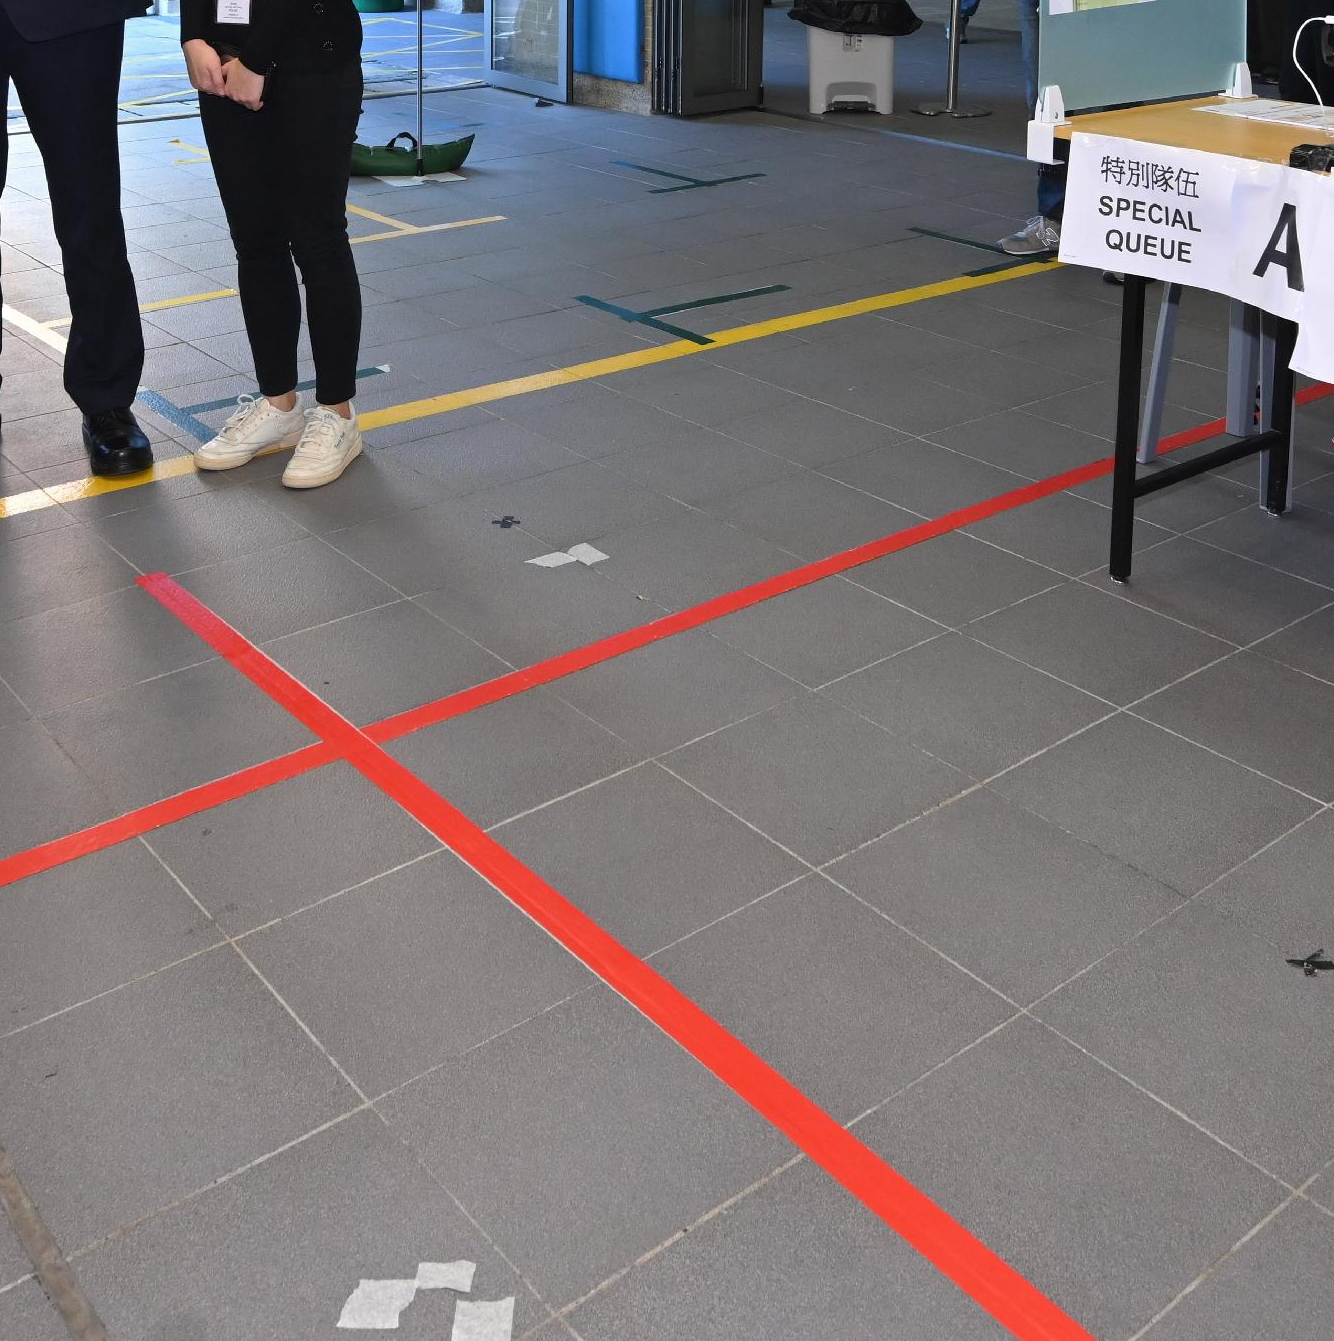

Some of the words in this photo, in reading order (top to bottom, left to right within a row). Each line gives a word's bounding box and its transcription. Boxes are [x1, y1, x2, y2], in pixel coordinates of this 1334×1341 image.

[1100, 155, 1200, 198] 特別隊伍
[1098, 195, 1202, 233] SPECIAL
[1105, 228, 1192, 264] QUEUE
[1252, 202, 1305, 293] A
